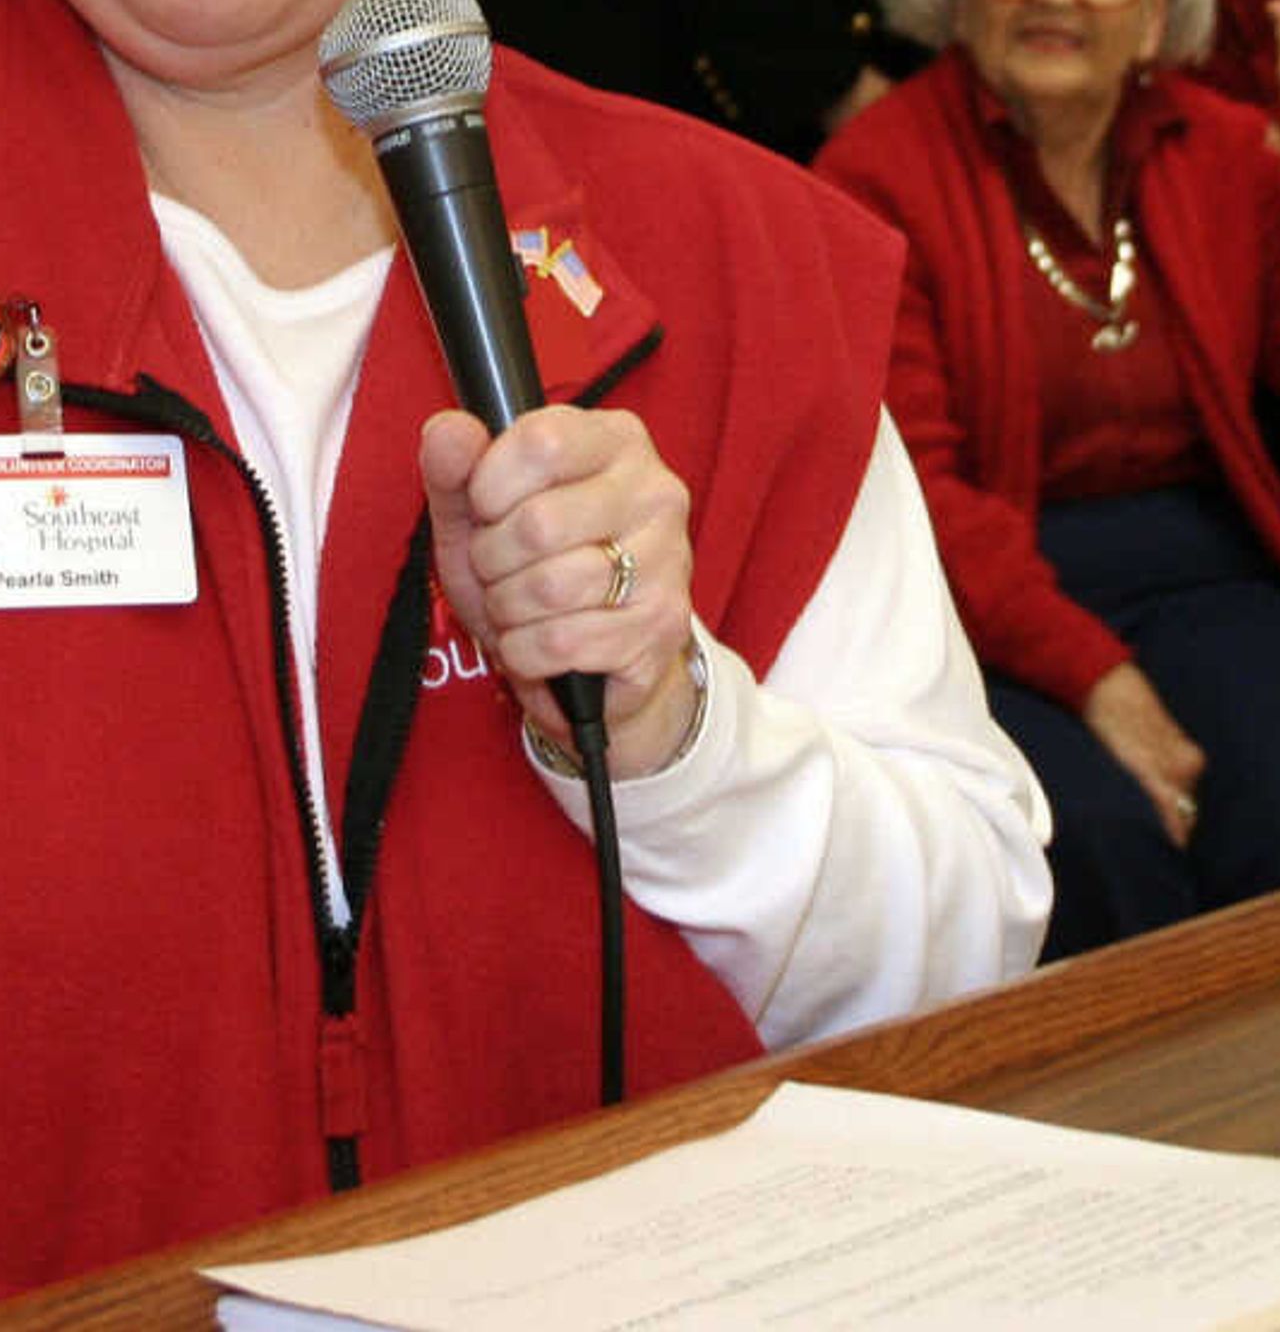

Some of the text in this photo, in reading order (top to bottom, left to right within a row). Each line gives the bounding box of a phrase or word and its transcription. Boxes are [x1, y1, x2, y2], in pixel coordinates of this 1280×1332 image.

[23, 500, 141, 528] Southeast
[39, 528, 134, 553] Hospital
[60, 569, 119, 588] Smith
